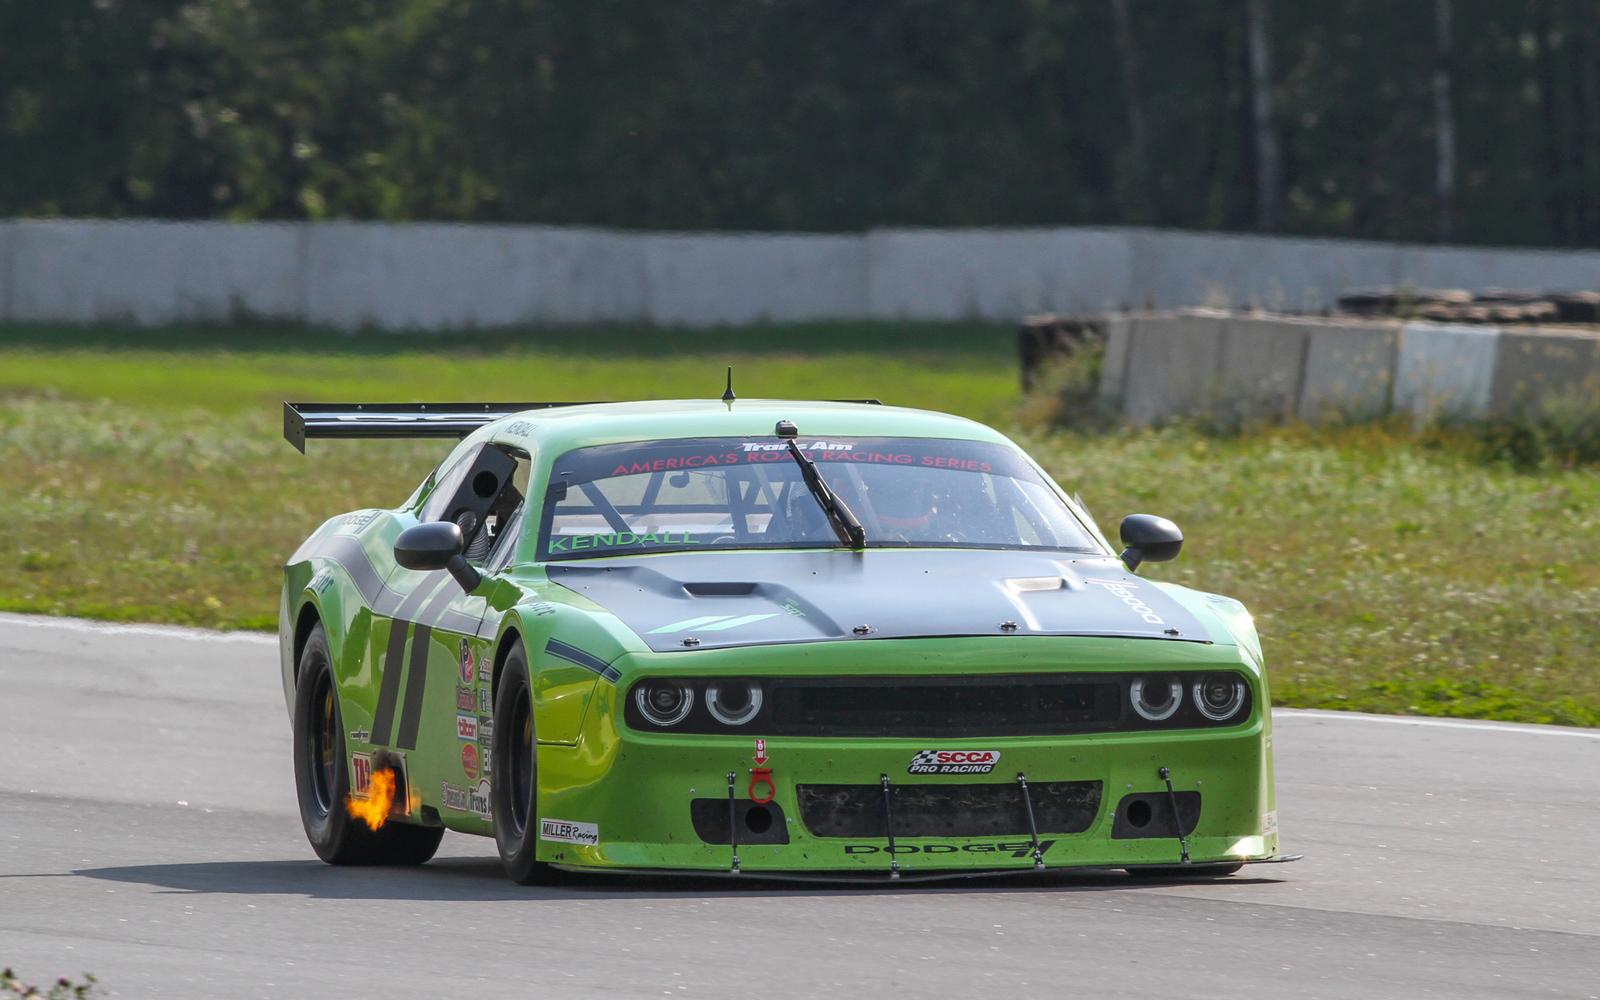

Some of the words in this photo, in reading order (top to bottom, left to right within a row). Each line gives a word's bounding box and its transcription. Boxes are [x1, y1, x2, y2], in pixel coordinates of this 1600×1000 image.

[810, 441, 853, 451] Am
[612, 453, 738, 476] AMERICA'S
[822, 450, 913, 465] RACING
[921, 456, 993, 472] SERIES
[548, 531, 700, 554] KENDALL
[936, 751, 993, 763] SCCA
[910, 765, 938, 773] PRO
[940, 765, 992, 773] RACING
[542, 823, 571, 838] MILLER
[572, 826, 598, 844] Racing
[844, 842, 1031, 854] DODGE
